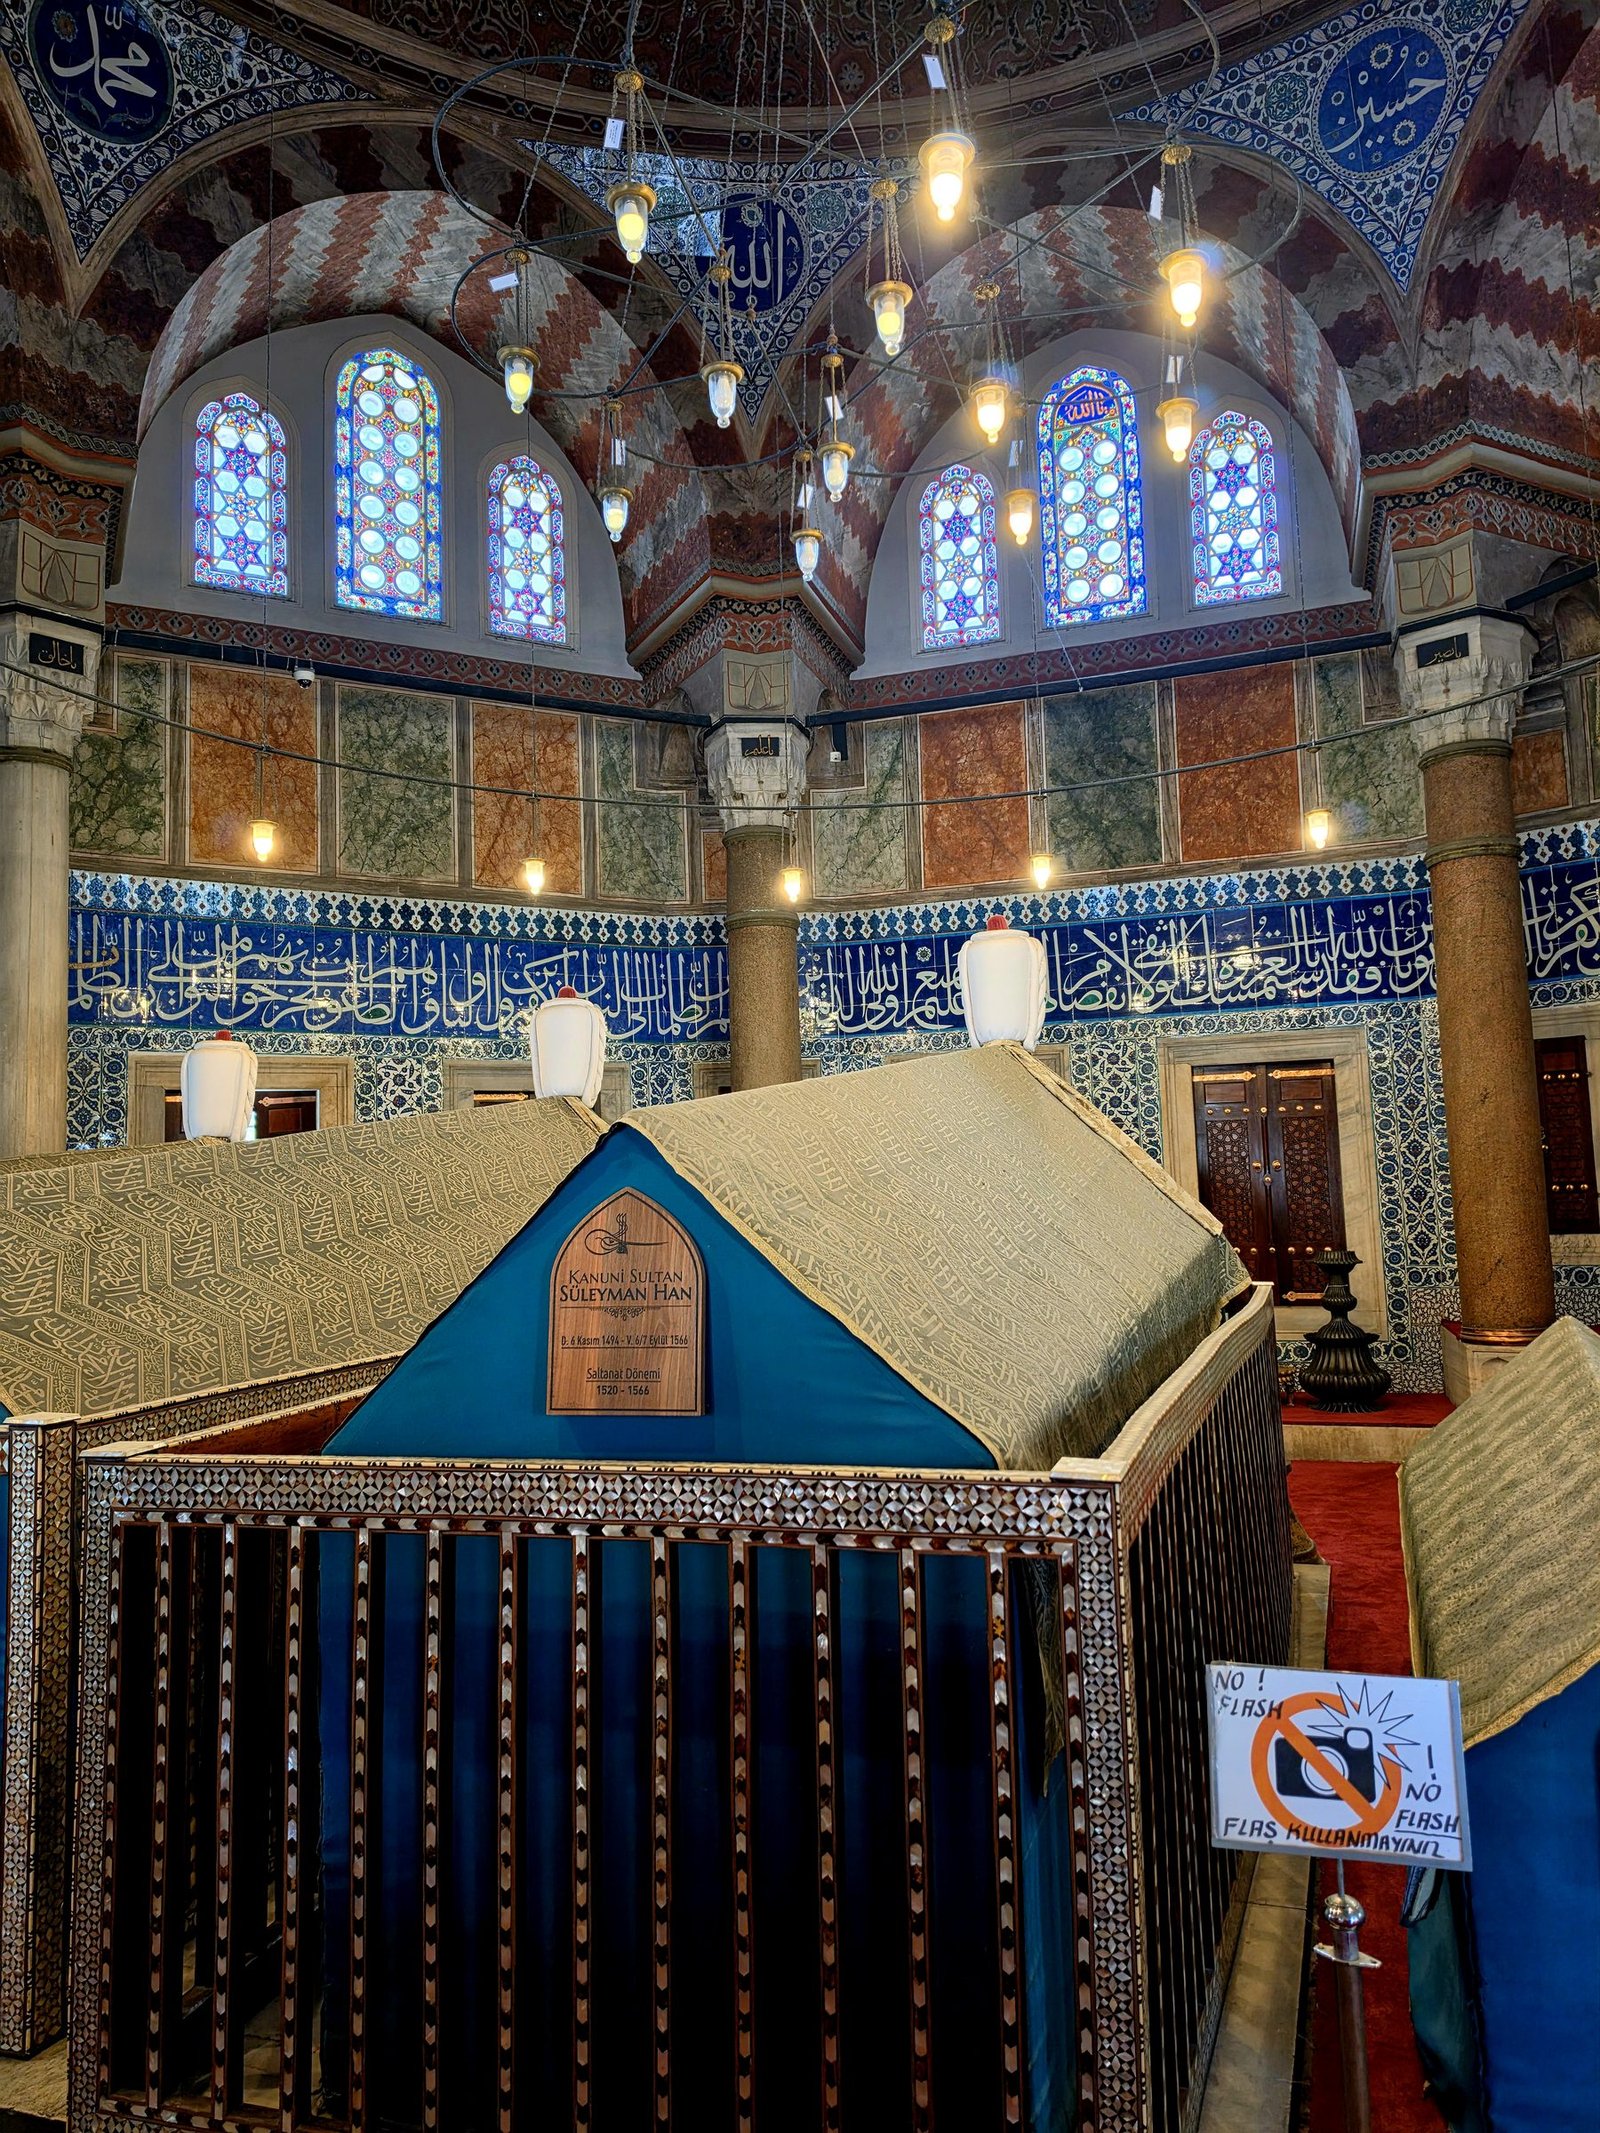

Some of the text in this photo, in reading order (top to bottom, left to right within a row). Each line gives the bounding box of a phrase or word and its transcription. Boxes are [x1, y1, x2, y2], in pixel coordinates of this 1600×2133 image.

[630, 1268, 684, 1284] SULTAN
[559, 1283, 693, 1302] SÜLEYMAN HAN
[570, 1335, 576, 1346] 6
[577, 1334, 600, 1346] Kasım
[601, 1335, 620, 1346] 1494
[634, 1335, 648, 1347] 6/7
[649, 1334, 668, 1348] Eylül
[670, 1334, 689, 1346] 1566
[586, 1367, 661, 1380] Saltanat Dönemi
[596, 1385, 618, 1396] 1520
[628, 1385, 650, 1396] 1566
[1214, 1669, 1245, 1691] NO
[1217, 1694, 1285, 1720] FLASH
[1405, 1783, 1442, 1802] NO
[1394, 1809, 1461, 1833] FLASH
